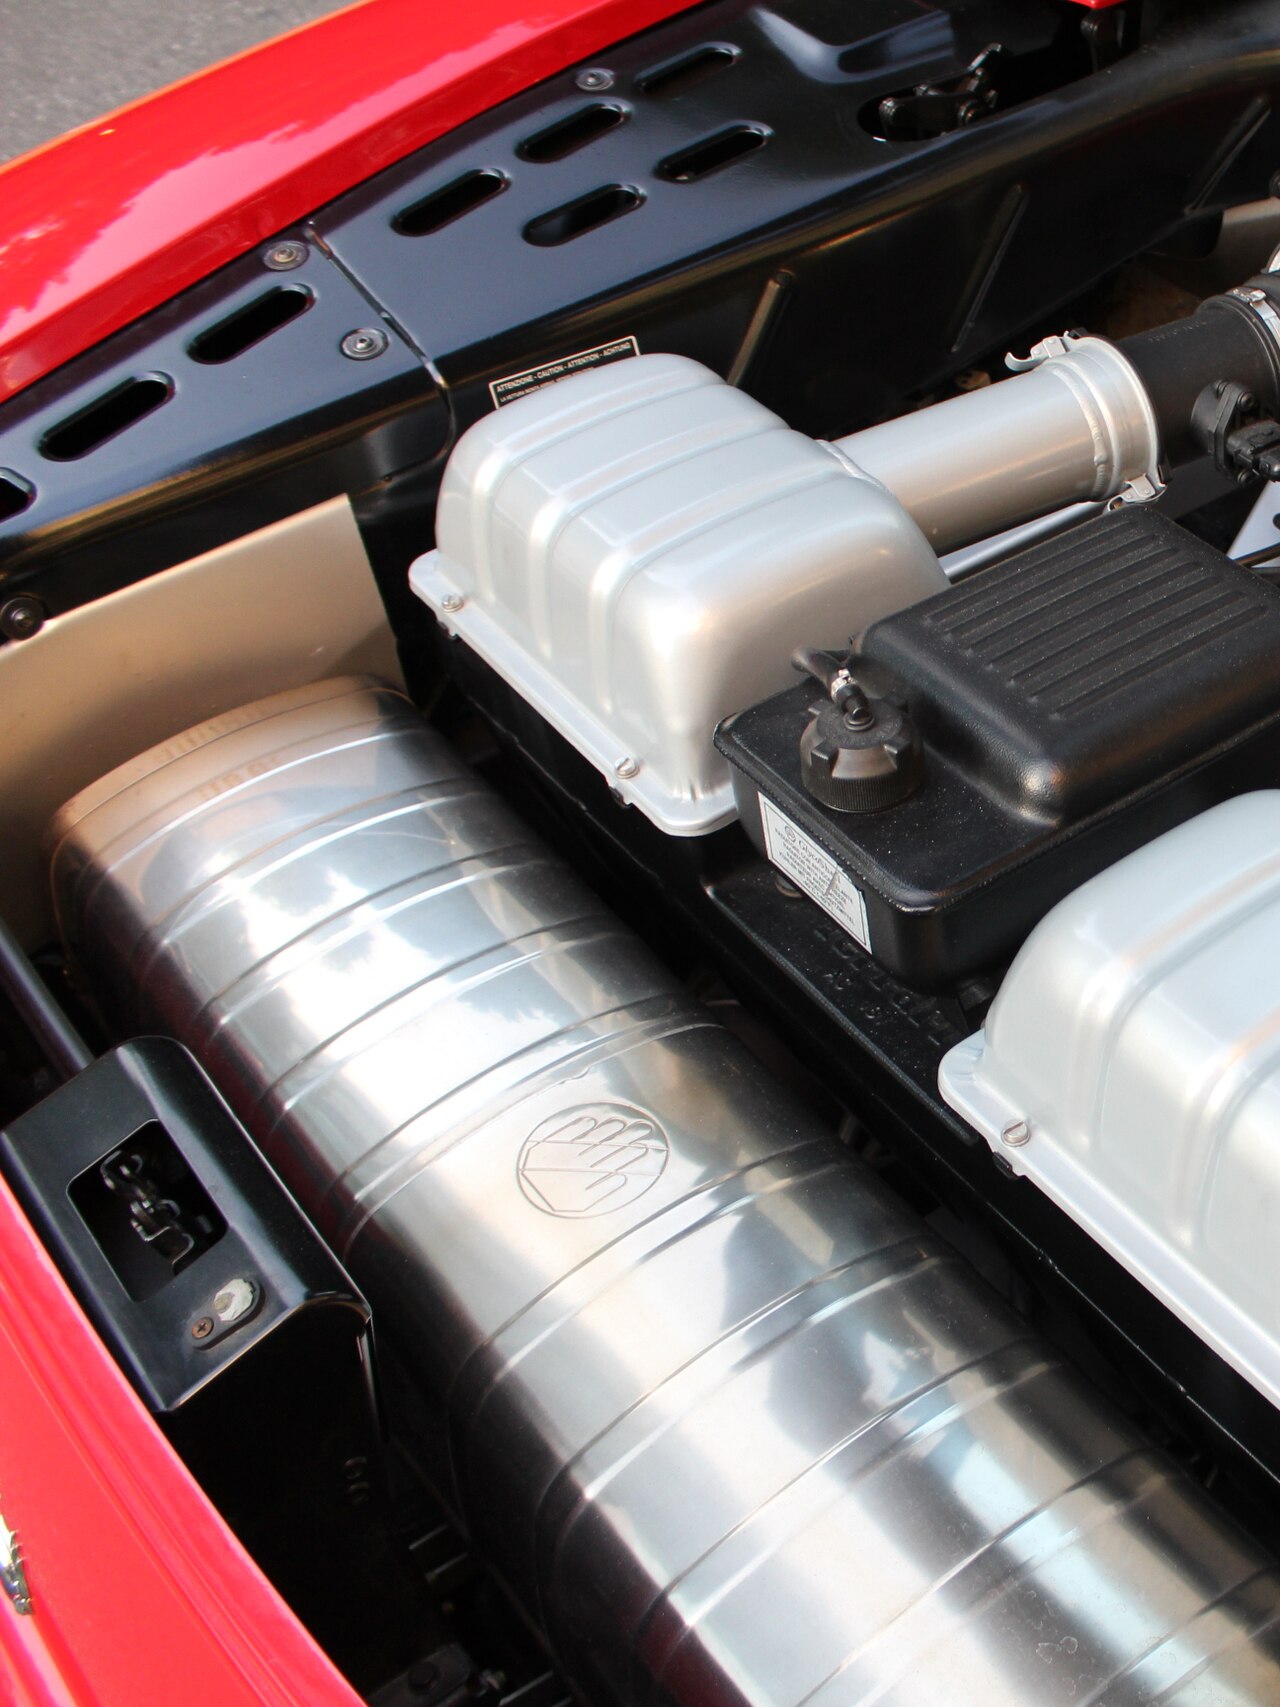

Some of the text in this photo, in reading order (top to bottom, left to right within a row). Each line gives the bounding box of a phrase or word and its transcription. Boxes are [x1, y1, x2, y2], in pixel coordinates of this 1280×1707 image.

[497, 375, 534, 392] ATTENZIONE
[537, 364, 564, 379] CAUTION
[567, 352, 599, 369] ATTENTION
[603, 342, 631, 356] ACHTUNG
